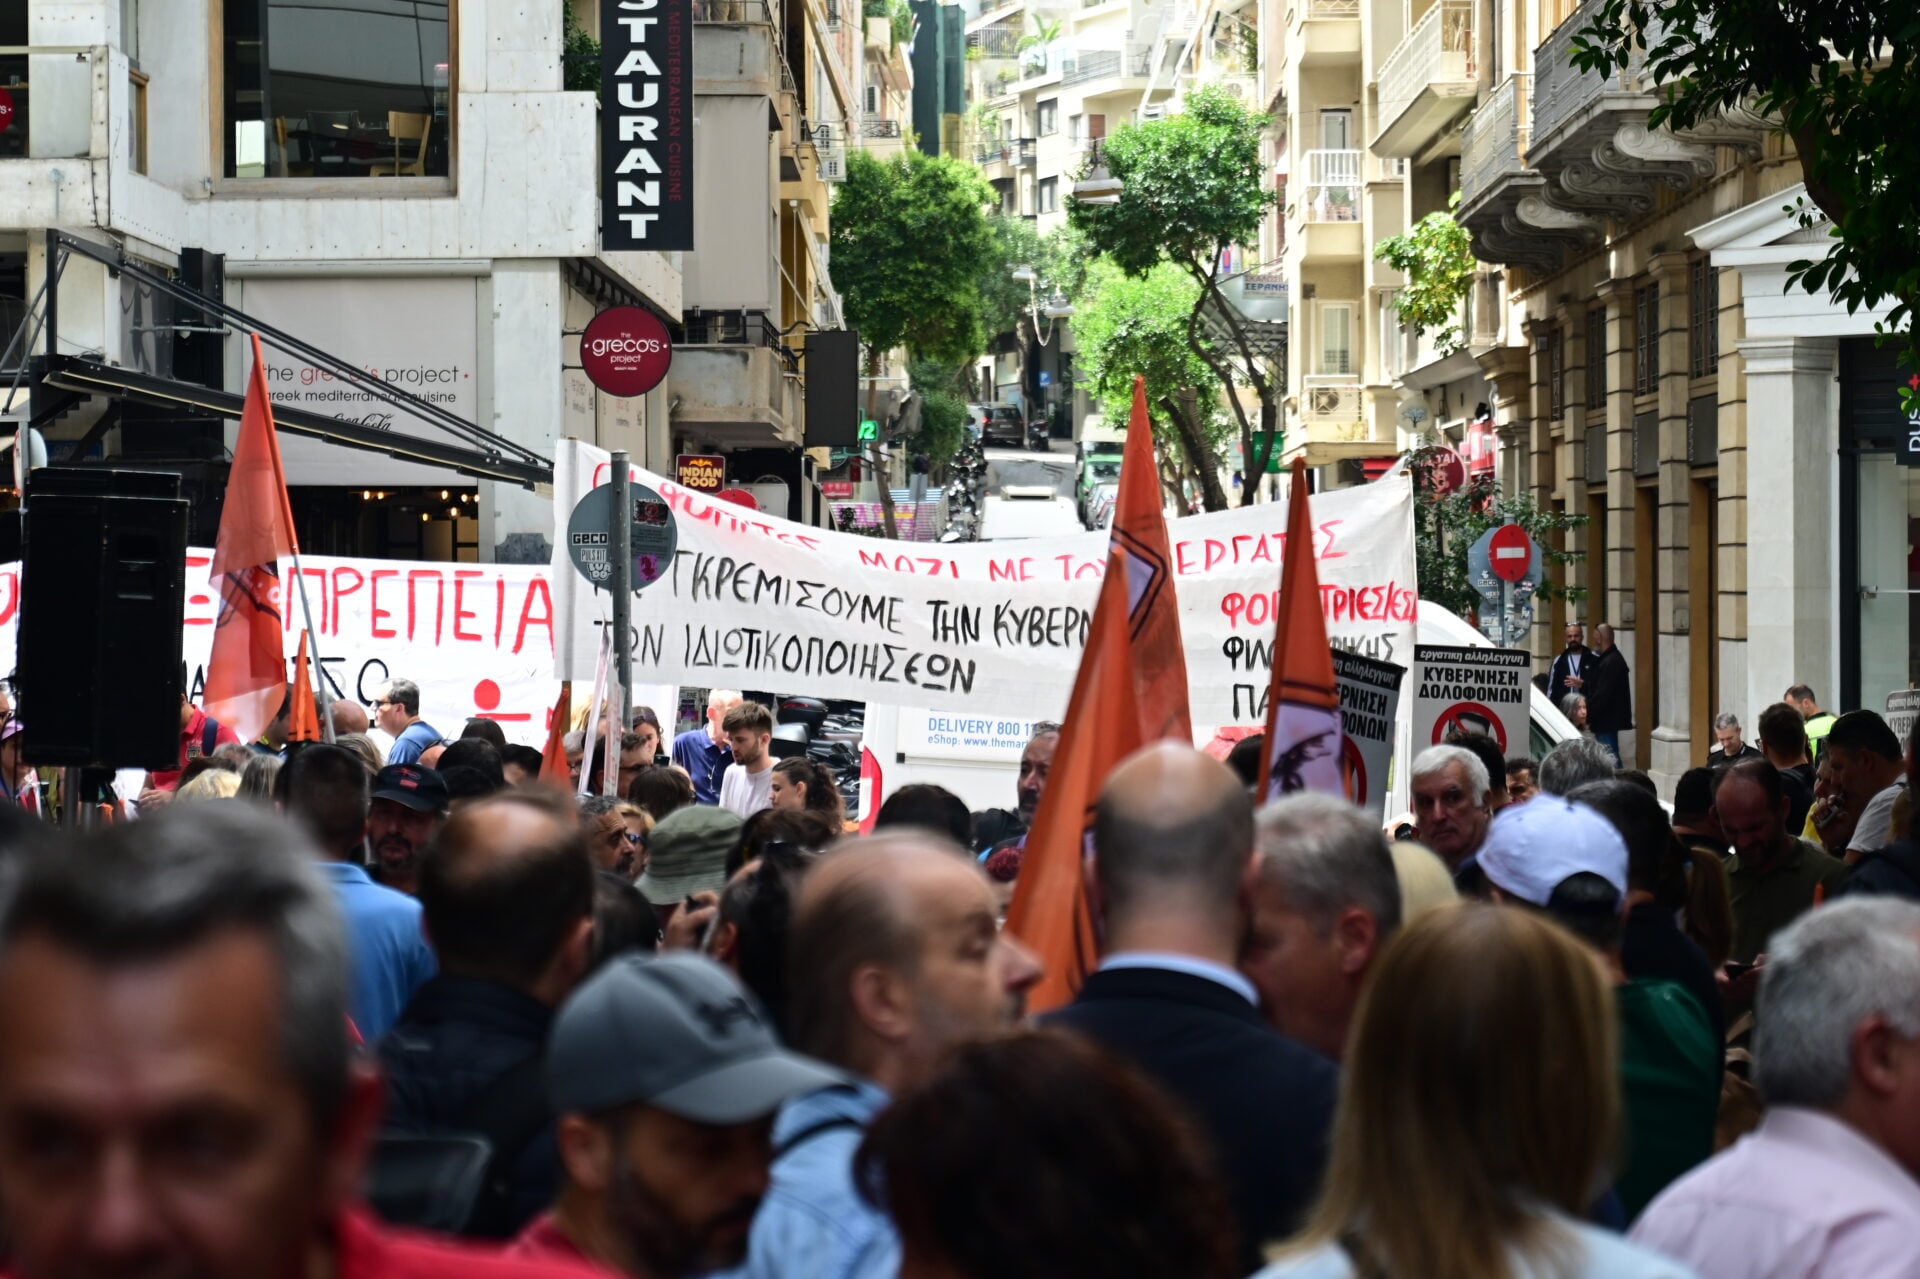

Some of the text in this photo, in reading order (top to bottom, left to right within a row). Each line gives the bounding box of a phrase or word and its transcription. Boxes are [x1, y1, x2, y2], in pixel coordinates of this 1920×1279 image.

[667, 12, 682, 137] MEDITERRANEAN
[668, 143, 682, 201] CUISINE
[592, 339, 660, 357] greco's
[610, 354, 642, 364] project
[385, 365, 459, 386] project
[268, 389, 301, 402] reek
[679, 466, 722, 478] INDIAN
[682, 477, 718, 488] FOOD
[1175, 519, 1348, 576] ΕΡΓΑΤΣ
[926, 600, 982, 645] ΤΗΝ
[992, 599, 1093, 648] ΚΥΒΕΡΝ
[1423, 667, 1519, 687] ΚΥΒΕΡΝΗΣΗ
[1418, 683, 1523, 703] ΔΟΛΟΦΟΝΩΝ
[928, 717, 993, 735] DELIVERY
[997, 721, 1020, 736] 800
[927, 734, 961, 747] eShop:
